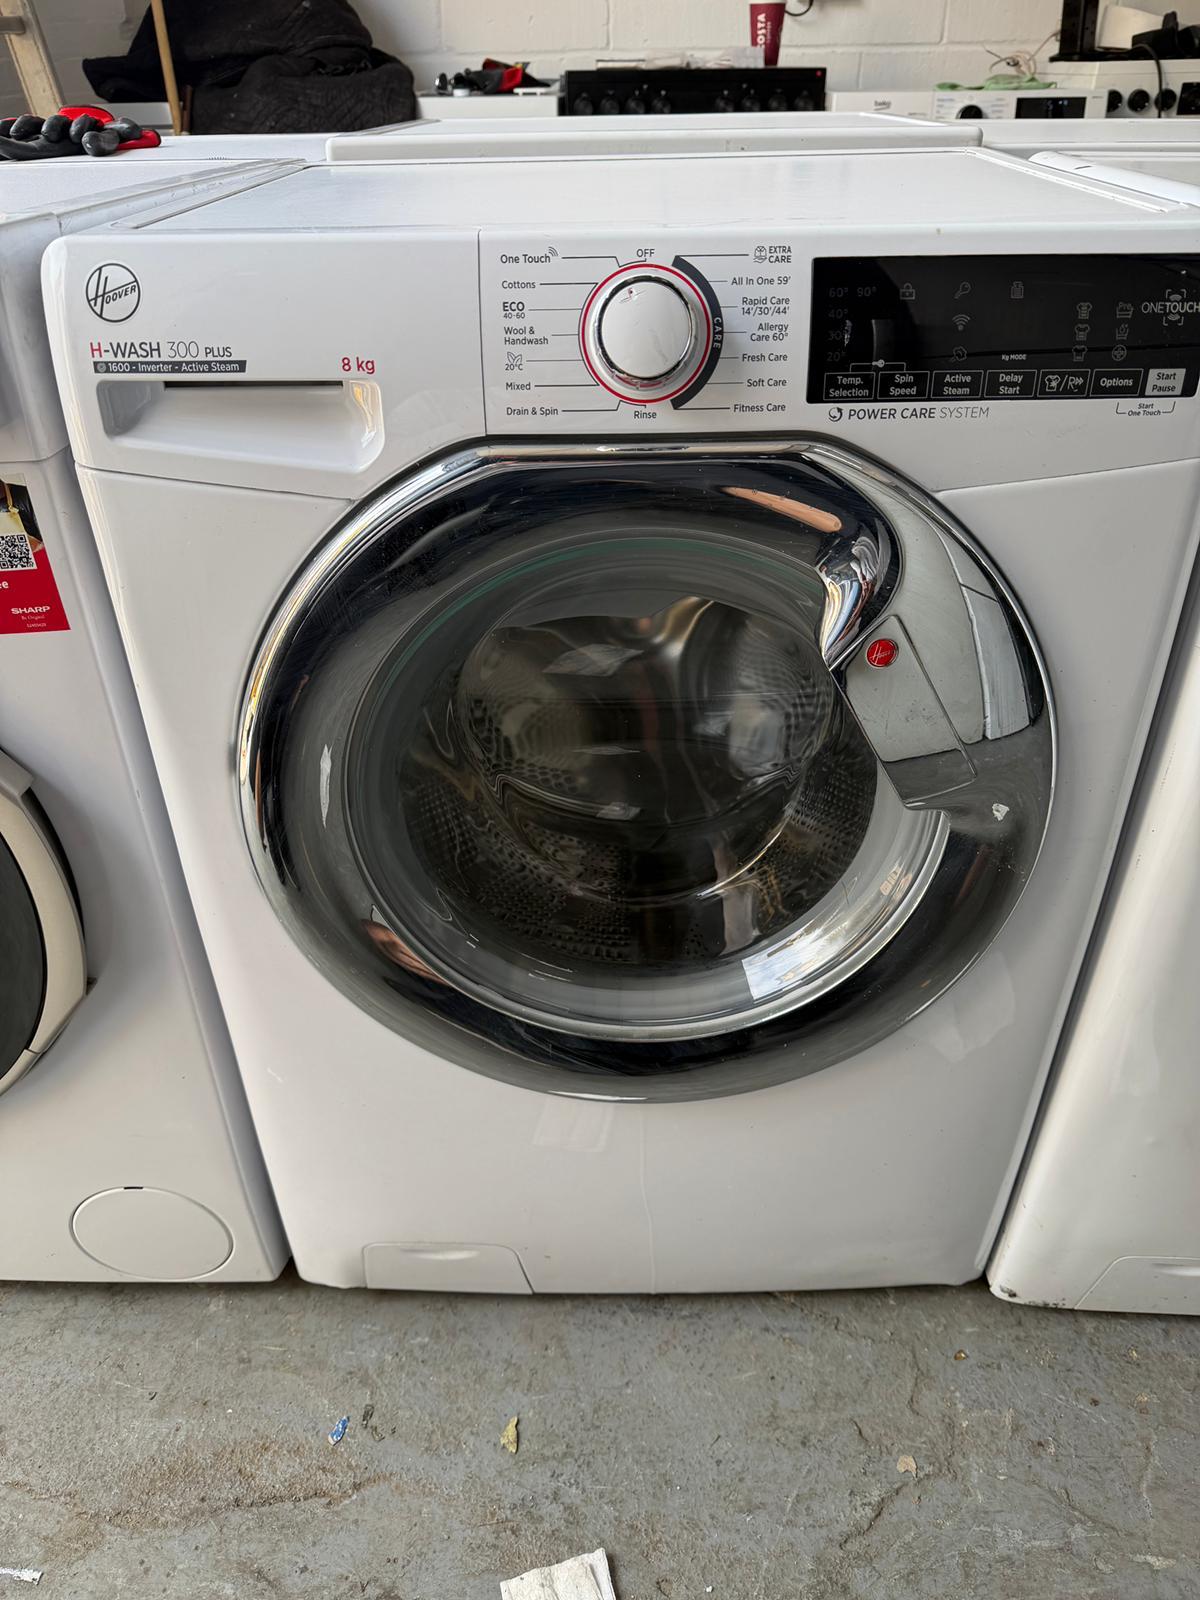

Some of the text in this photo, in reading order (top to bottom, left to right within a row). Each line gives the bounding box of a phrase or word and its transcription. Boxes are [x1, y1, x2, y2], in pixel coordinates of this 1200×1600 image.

[636, 249, 655, 258] OFF
[768, 245, 792, 254] EXTRA
[500, 253, 551, 264] One Touch
[768, 255, 792, 263] CARE
[501, 280, 536, 289] Cottons
[731, 277, 743, 285] All
[746, 277, 754, 285] In
[756, 276, 775, 285] One
[741, 296, 790, 306] Rapid Care
[502, 301, 525, 312] ECO
[504, 326, 535, 335] Wool &
[757, 322, 789, 332] Allergy
[713, 317, 722, 349] CARE
[750, 333, 770, 341] Care
[504, 336, 549, 345] Handwash
[89, 341, 232, 358] H-WASH 300 PLUS
[742, 353, 788, 362] Fresh Care
[108, 363, 131, 372] 1600
[138, 363, 172, 372] Inverter
[181, 362, 208, 372] Active
[211, 362, 240, 371] Steam
[342, 356, 375, 375] 8 kg
[505, 363, 524, 371] 20°C
[837, 375, 864, 385] Temp.
[894, 373, 914, 384] Spin
[944, 373, 972, 383] Active
[999, 373, 1023, 383] Delay
[1156, 372, 1177, 380] Start
[505, 382, 531, 390] Mixed
[746, 378, 787, 387] Soft Care
[1100, 377, 1133, 388] Options
[828, 388, 869, 397] Selection
[889, 386, 917, 396] Speed
[943, 386, 970, 395] Steam
[998, 385, 1020, 395] Start
[1152, 384, 1176, 392] Pause
[506, 407, 559, 417] Drain & Spin
[733, 403, 786, 413] Fitness Care
[848, 406, 990, 420] POWER CARE SYSTEM
[633, 410, 657, 419] Rinse
[11, 605, 51, 615] SHARP
